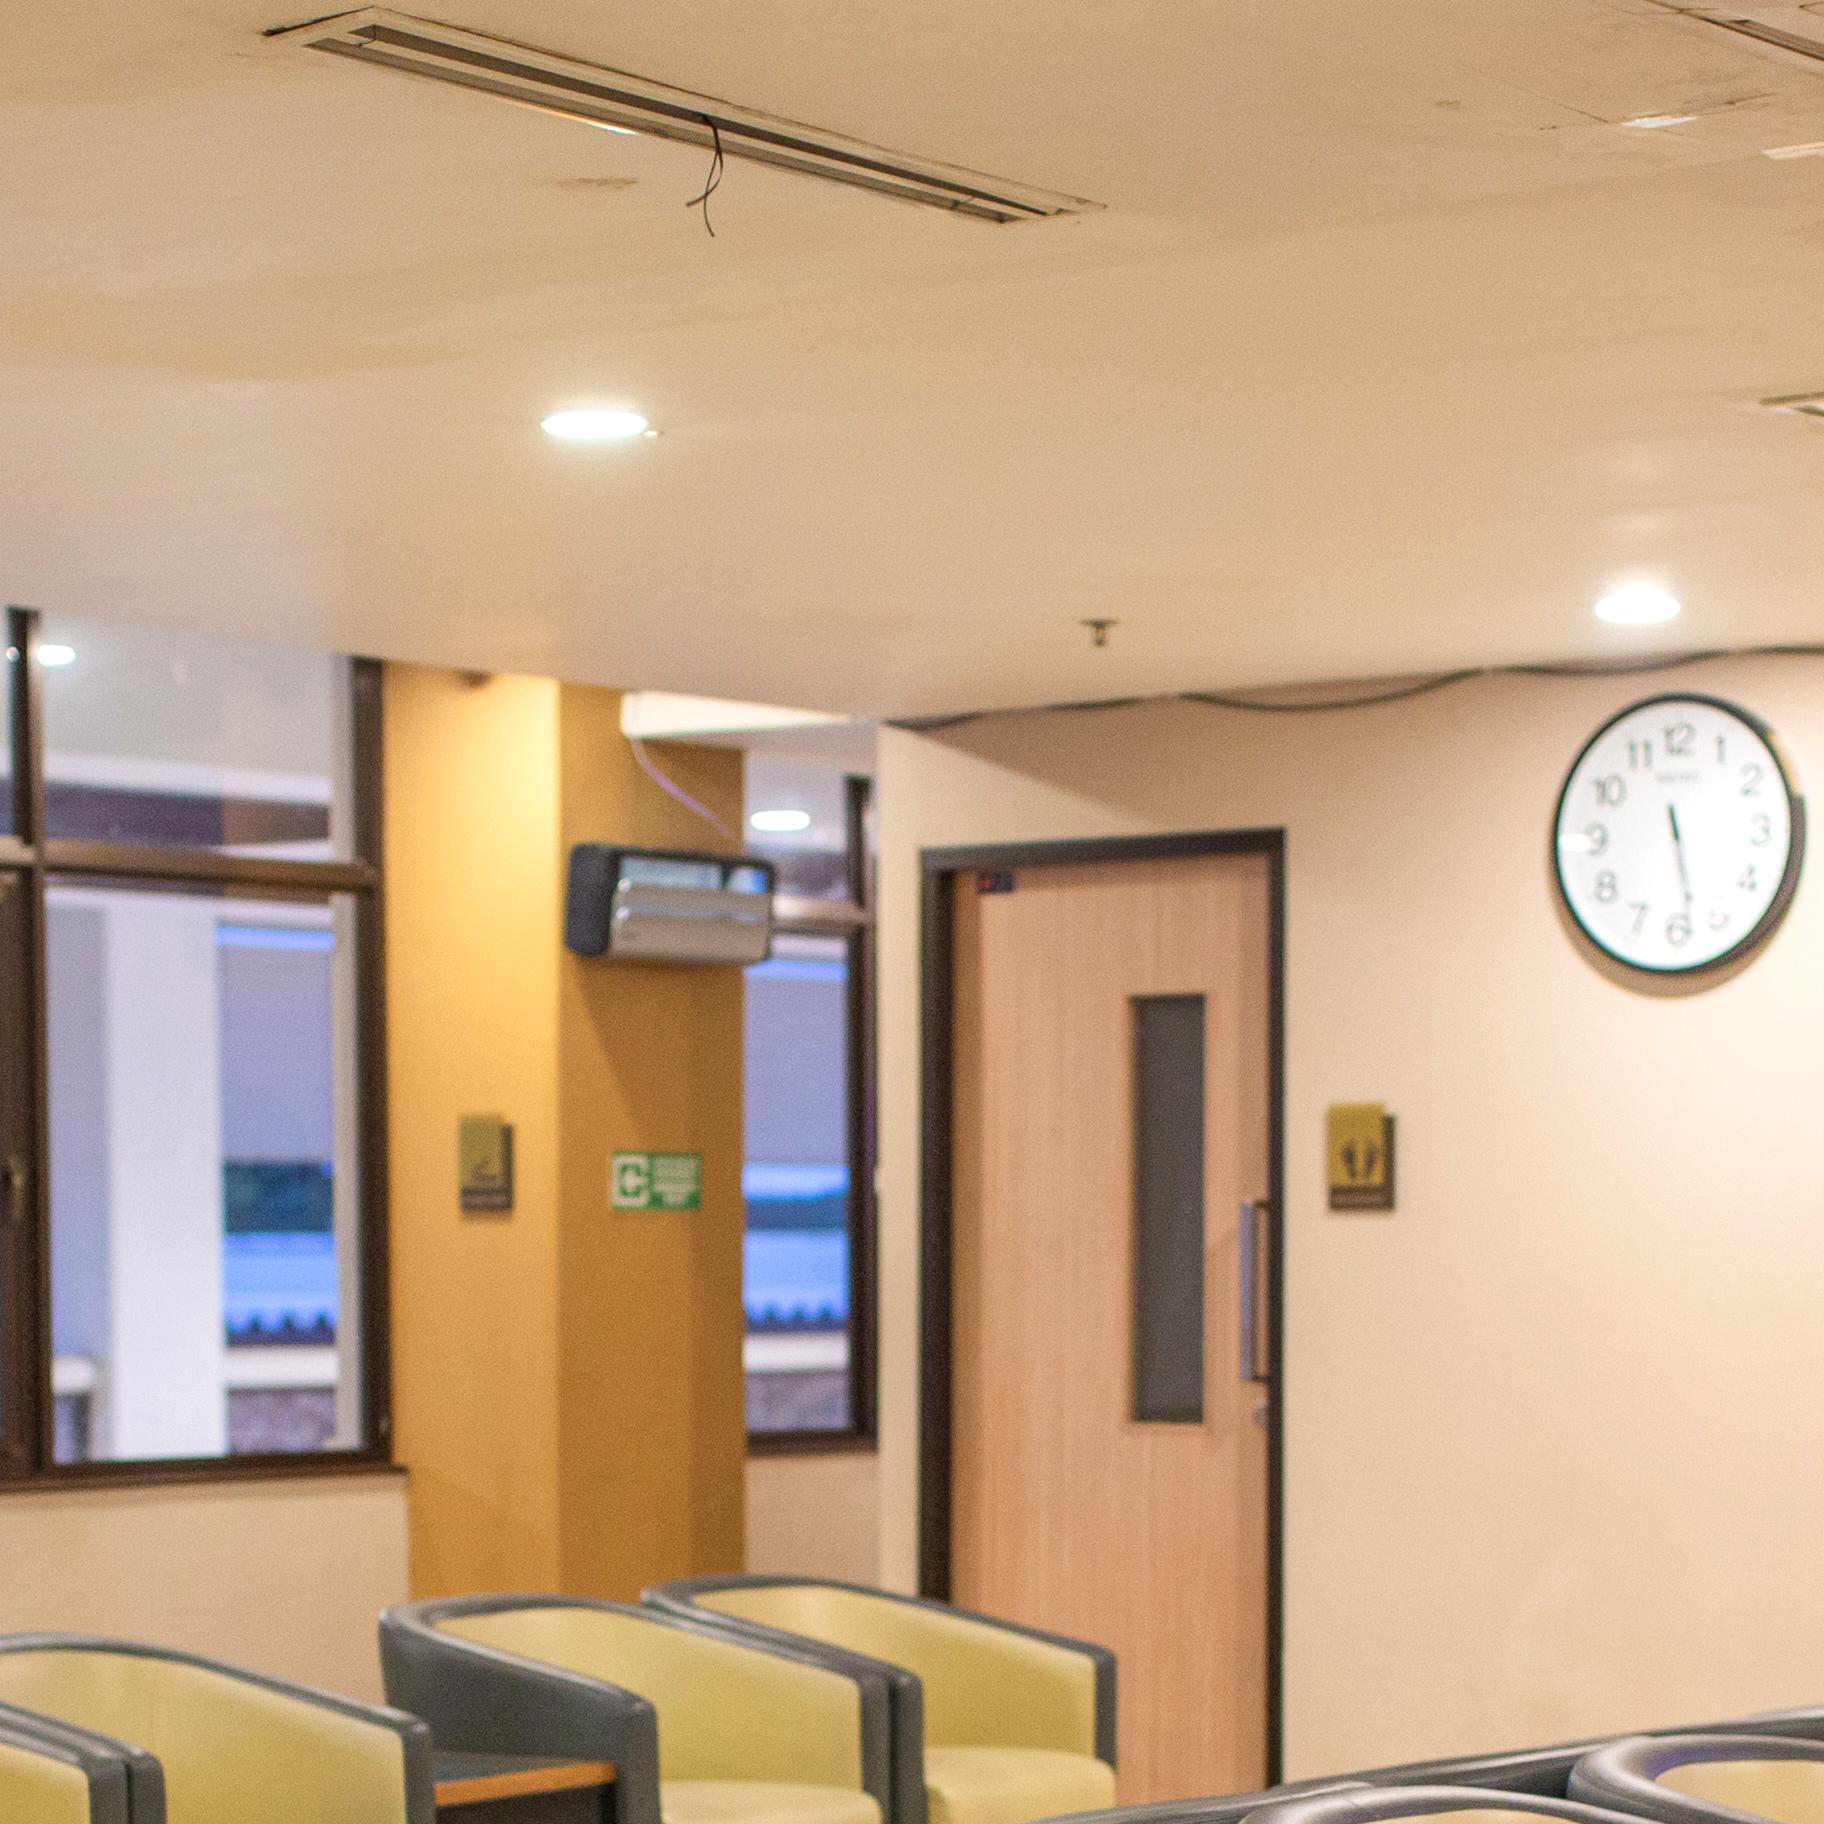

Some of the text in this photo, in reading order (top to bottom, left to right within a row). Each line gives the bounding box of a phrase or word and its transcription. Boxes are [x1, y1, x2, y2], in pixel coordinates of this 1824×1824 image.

[1627, 738, 1654, 770] 11
[1664, 722, 1696, 756] 12
[1714, 733, 1727, 764] 1
[1590, 774, 1627, 808] 10
[1739, 762, 1765, 797] 2
[1584, 821, 1609, 857] 9
[1749, 813, 1773, 848] 3
[1594, 869, 1619, 904] 8
[1737, 863, 1759, 892] 4
[1628, 901, 1649, 938] 7
[1665, 912, 1693, 947] 6
